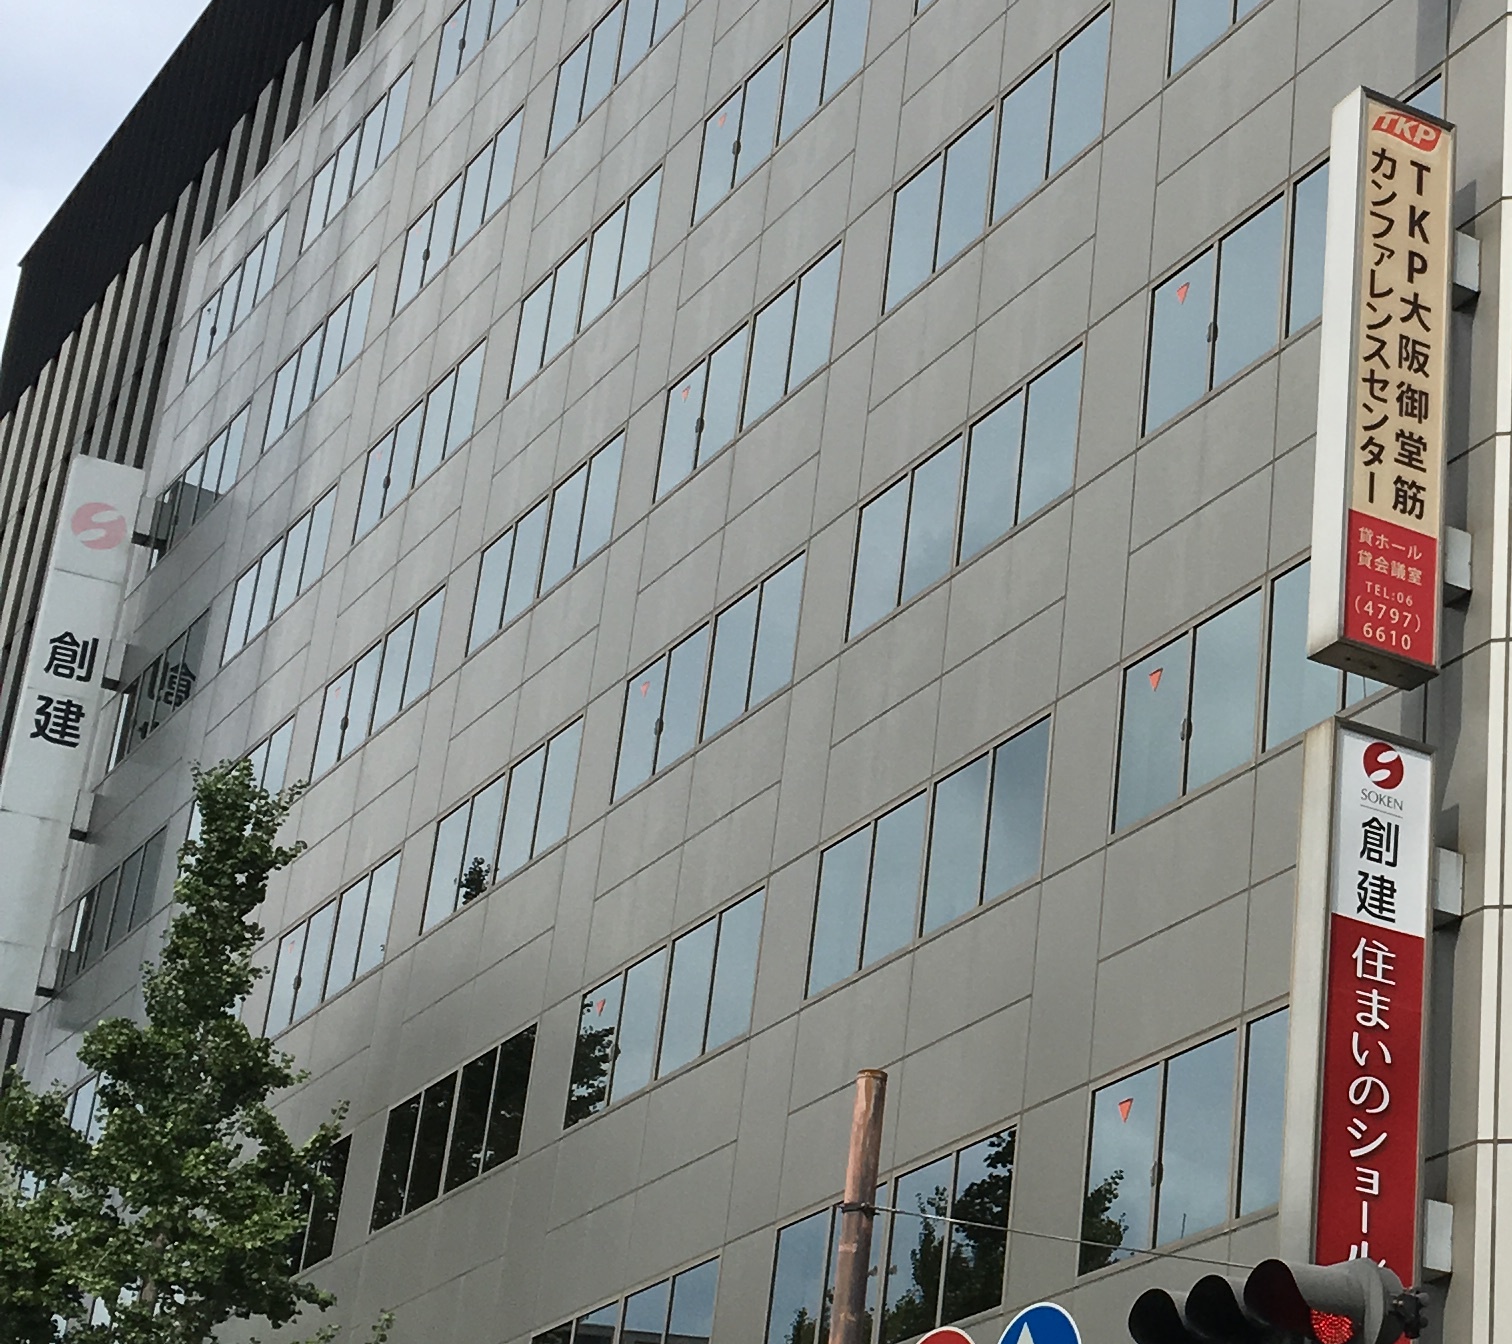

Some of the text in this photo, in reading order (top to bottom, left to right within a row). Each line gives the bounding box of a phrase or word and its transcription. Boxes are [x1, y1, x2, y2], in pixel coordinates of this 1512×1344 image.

[1376, 111, 1437, 146] TKP
[1360, 146, 1398, 505] カンファレンスセンター
[1392, 160, 1432, 521] TKP大阪御堂筋
[1358, 525, 1423, 561] 貸ホール
[1357, 548, 1424, 586] 貸会議室
[1365, 581, 1415, 607] TEL:06
[1354, 595, 1422, 633] (4797)
[1362, 620, 1412, 652] 6610
[29, 630, 100, 749] 創建
[1360, 788, 1404, 811] SOKEN
[1356, 815, 1400, 924] 創建
